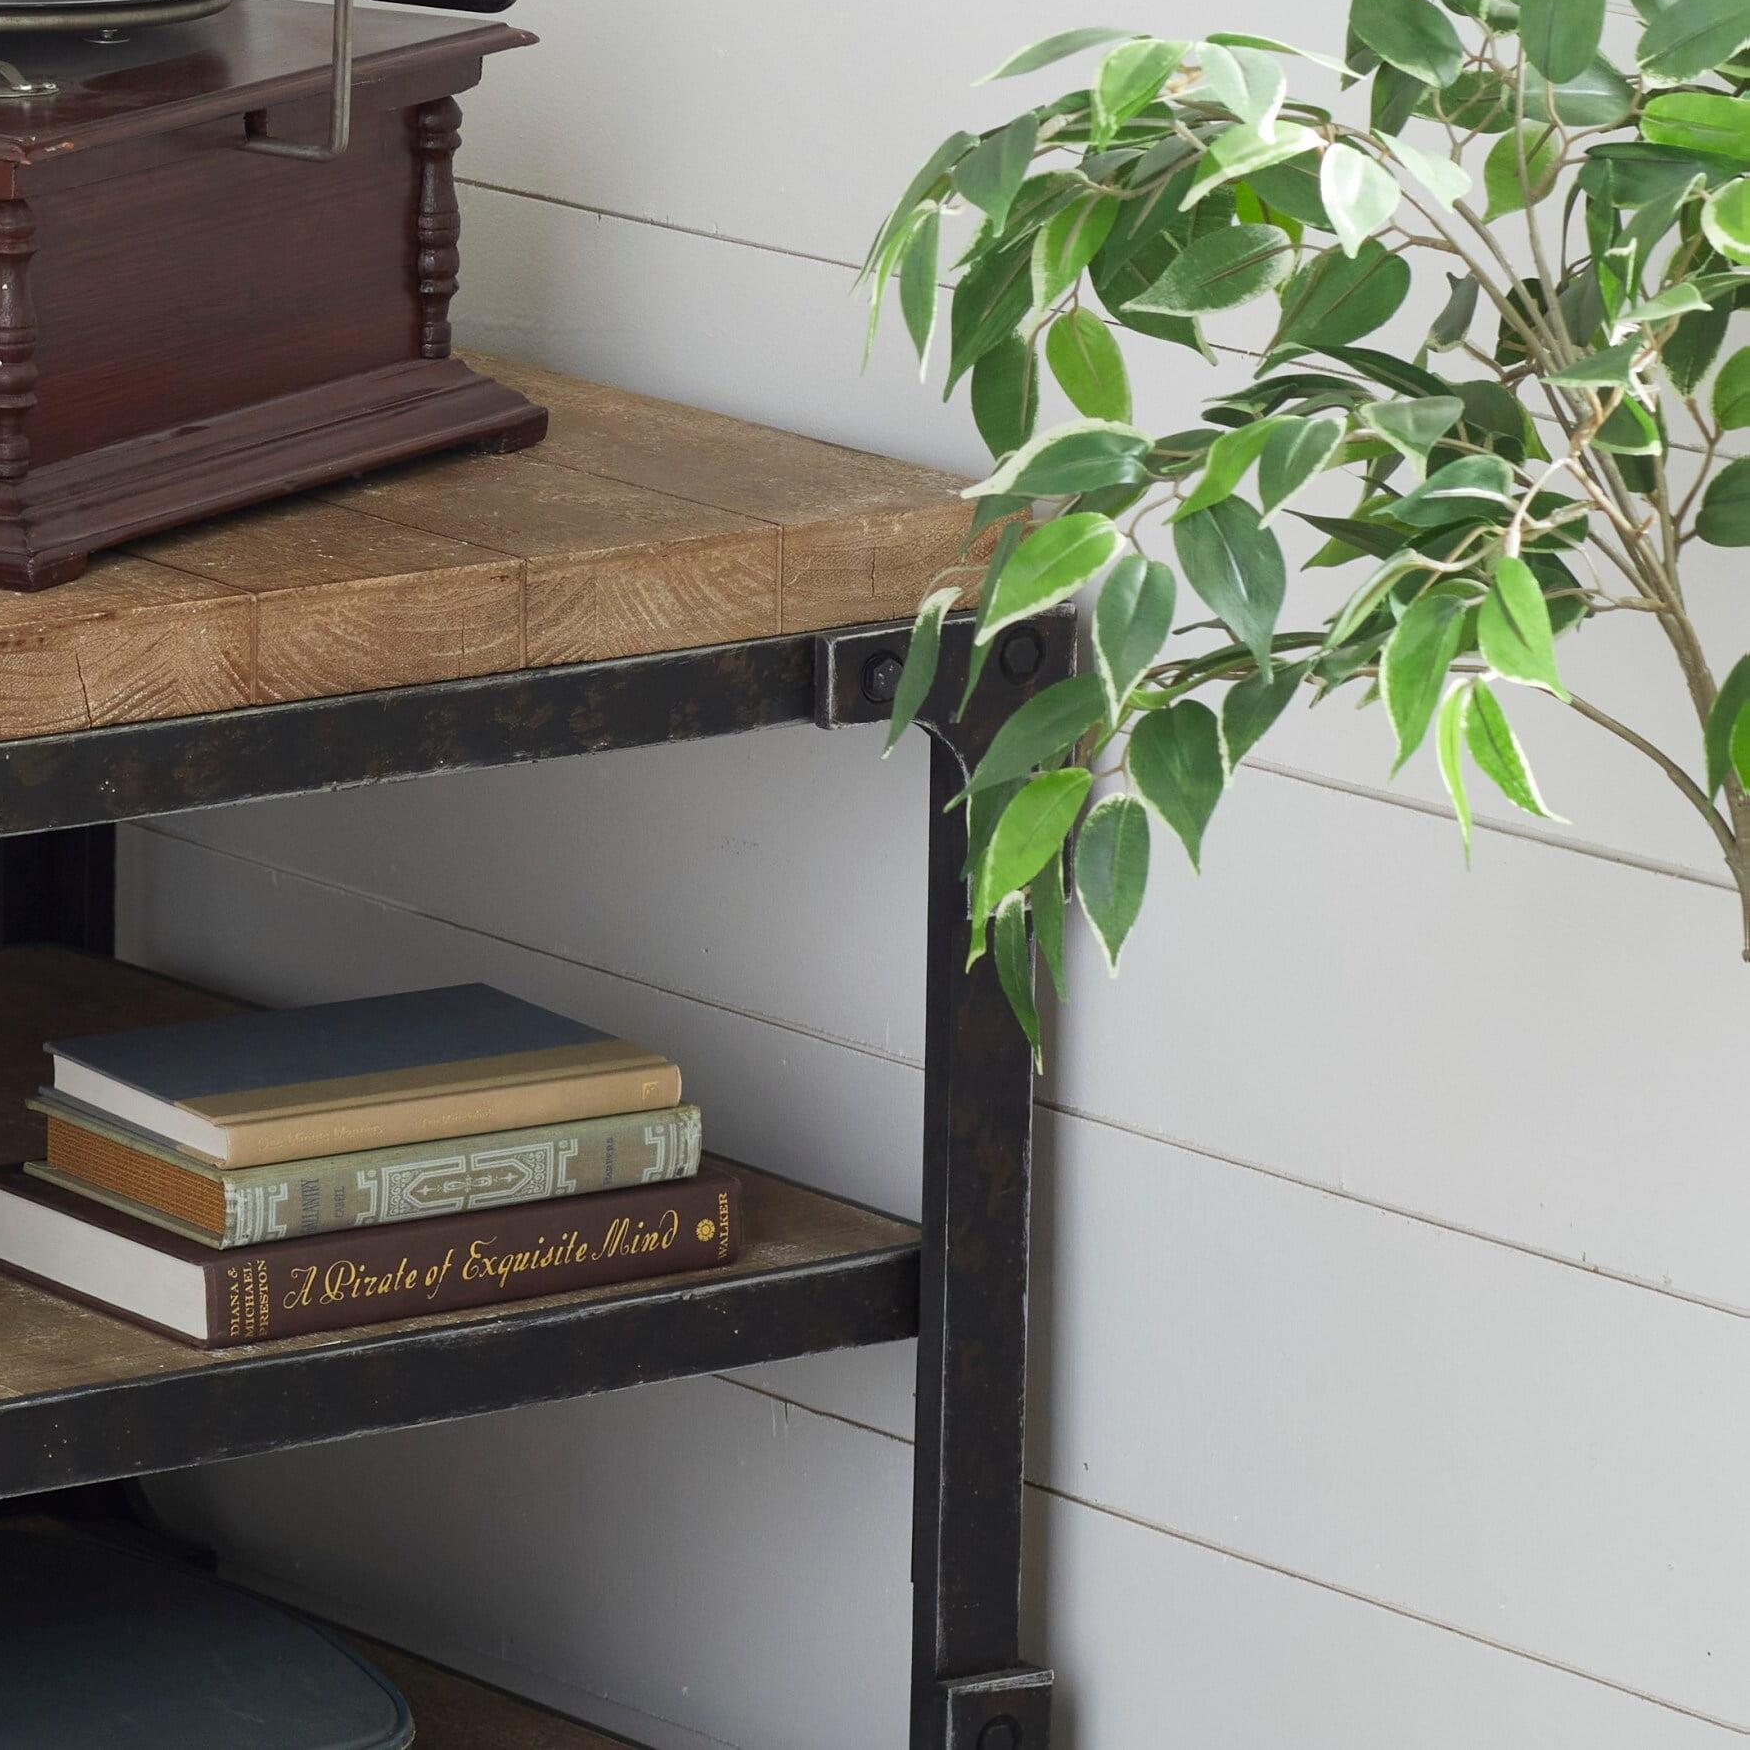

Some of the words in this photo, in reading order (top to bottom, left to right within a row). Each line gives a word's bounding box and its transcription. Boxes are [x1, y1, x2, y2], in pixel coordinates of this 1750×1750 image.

[282, 1265, 317, 1309] A
[319, 1257, 418, 1305] Pirate
[424, 1248, 455, 1300] of
[462, 1230, 588, 1289] Exquisite
[591, 1209, 679, 1261] Mind
[718, 1192, 729, 1259] WALKER
[227, 1267, 238, 1279] &
[243, 1262, 255, 1338] MICHAEL
[256, 1259, 269, 1337] PRESTON
[230, 1282, 241, 1337] DIANA
